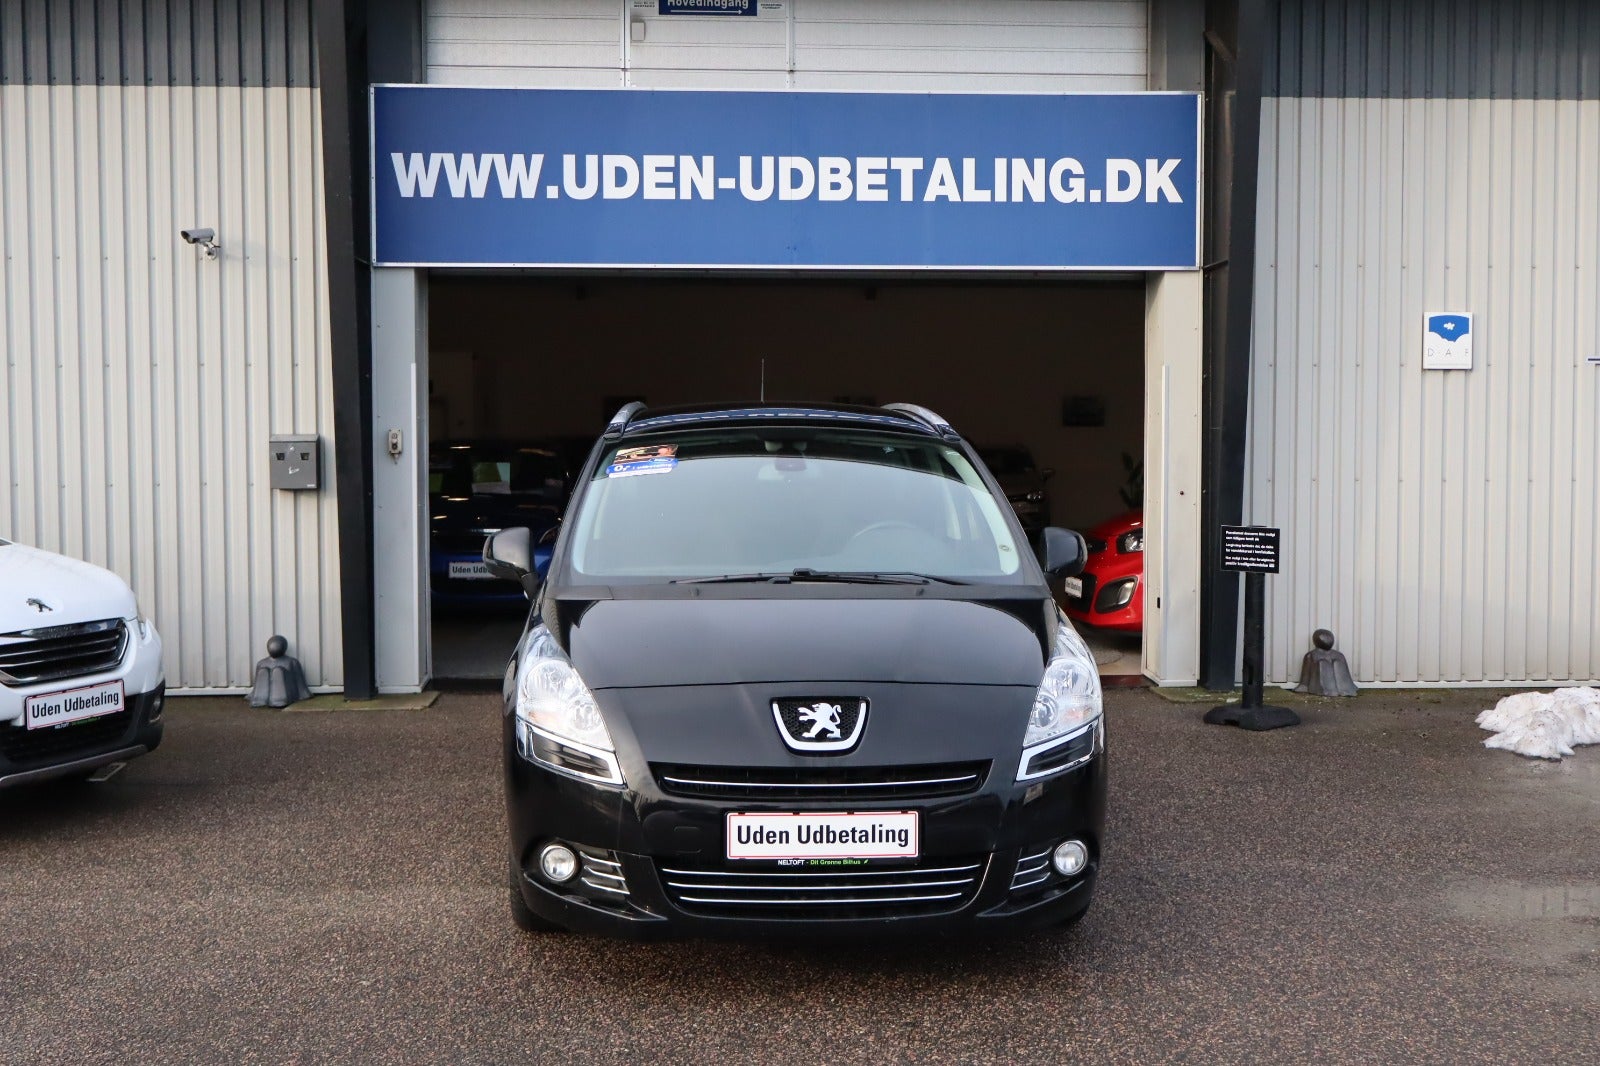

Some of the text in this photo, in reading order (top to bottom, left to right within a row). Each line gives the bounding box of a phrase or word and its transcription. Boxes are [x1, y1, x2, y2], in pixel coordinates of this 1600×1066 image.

[390, 152, 1184, 204] WWW.UDEN-UDBETALING.DK
[453, 564, 471, 573] Uden
[32, 691, 119, 719] Uden Udbetaling
[737, 824, 909, 848] Uden Udbetaling
